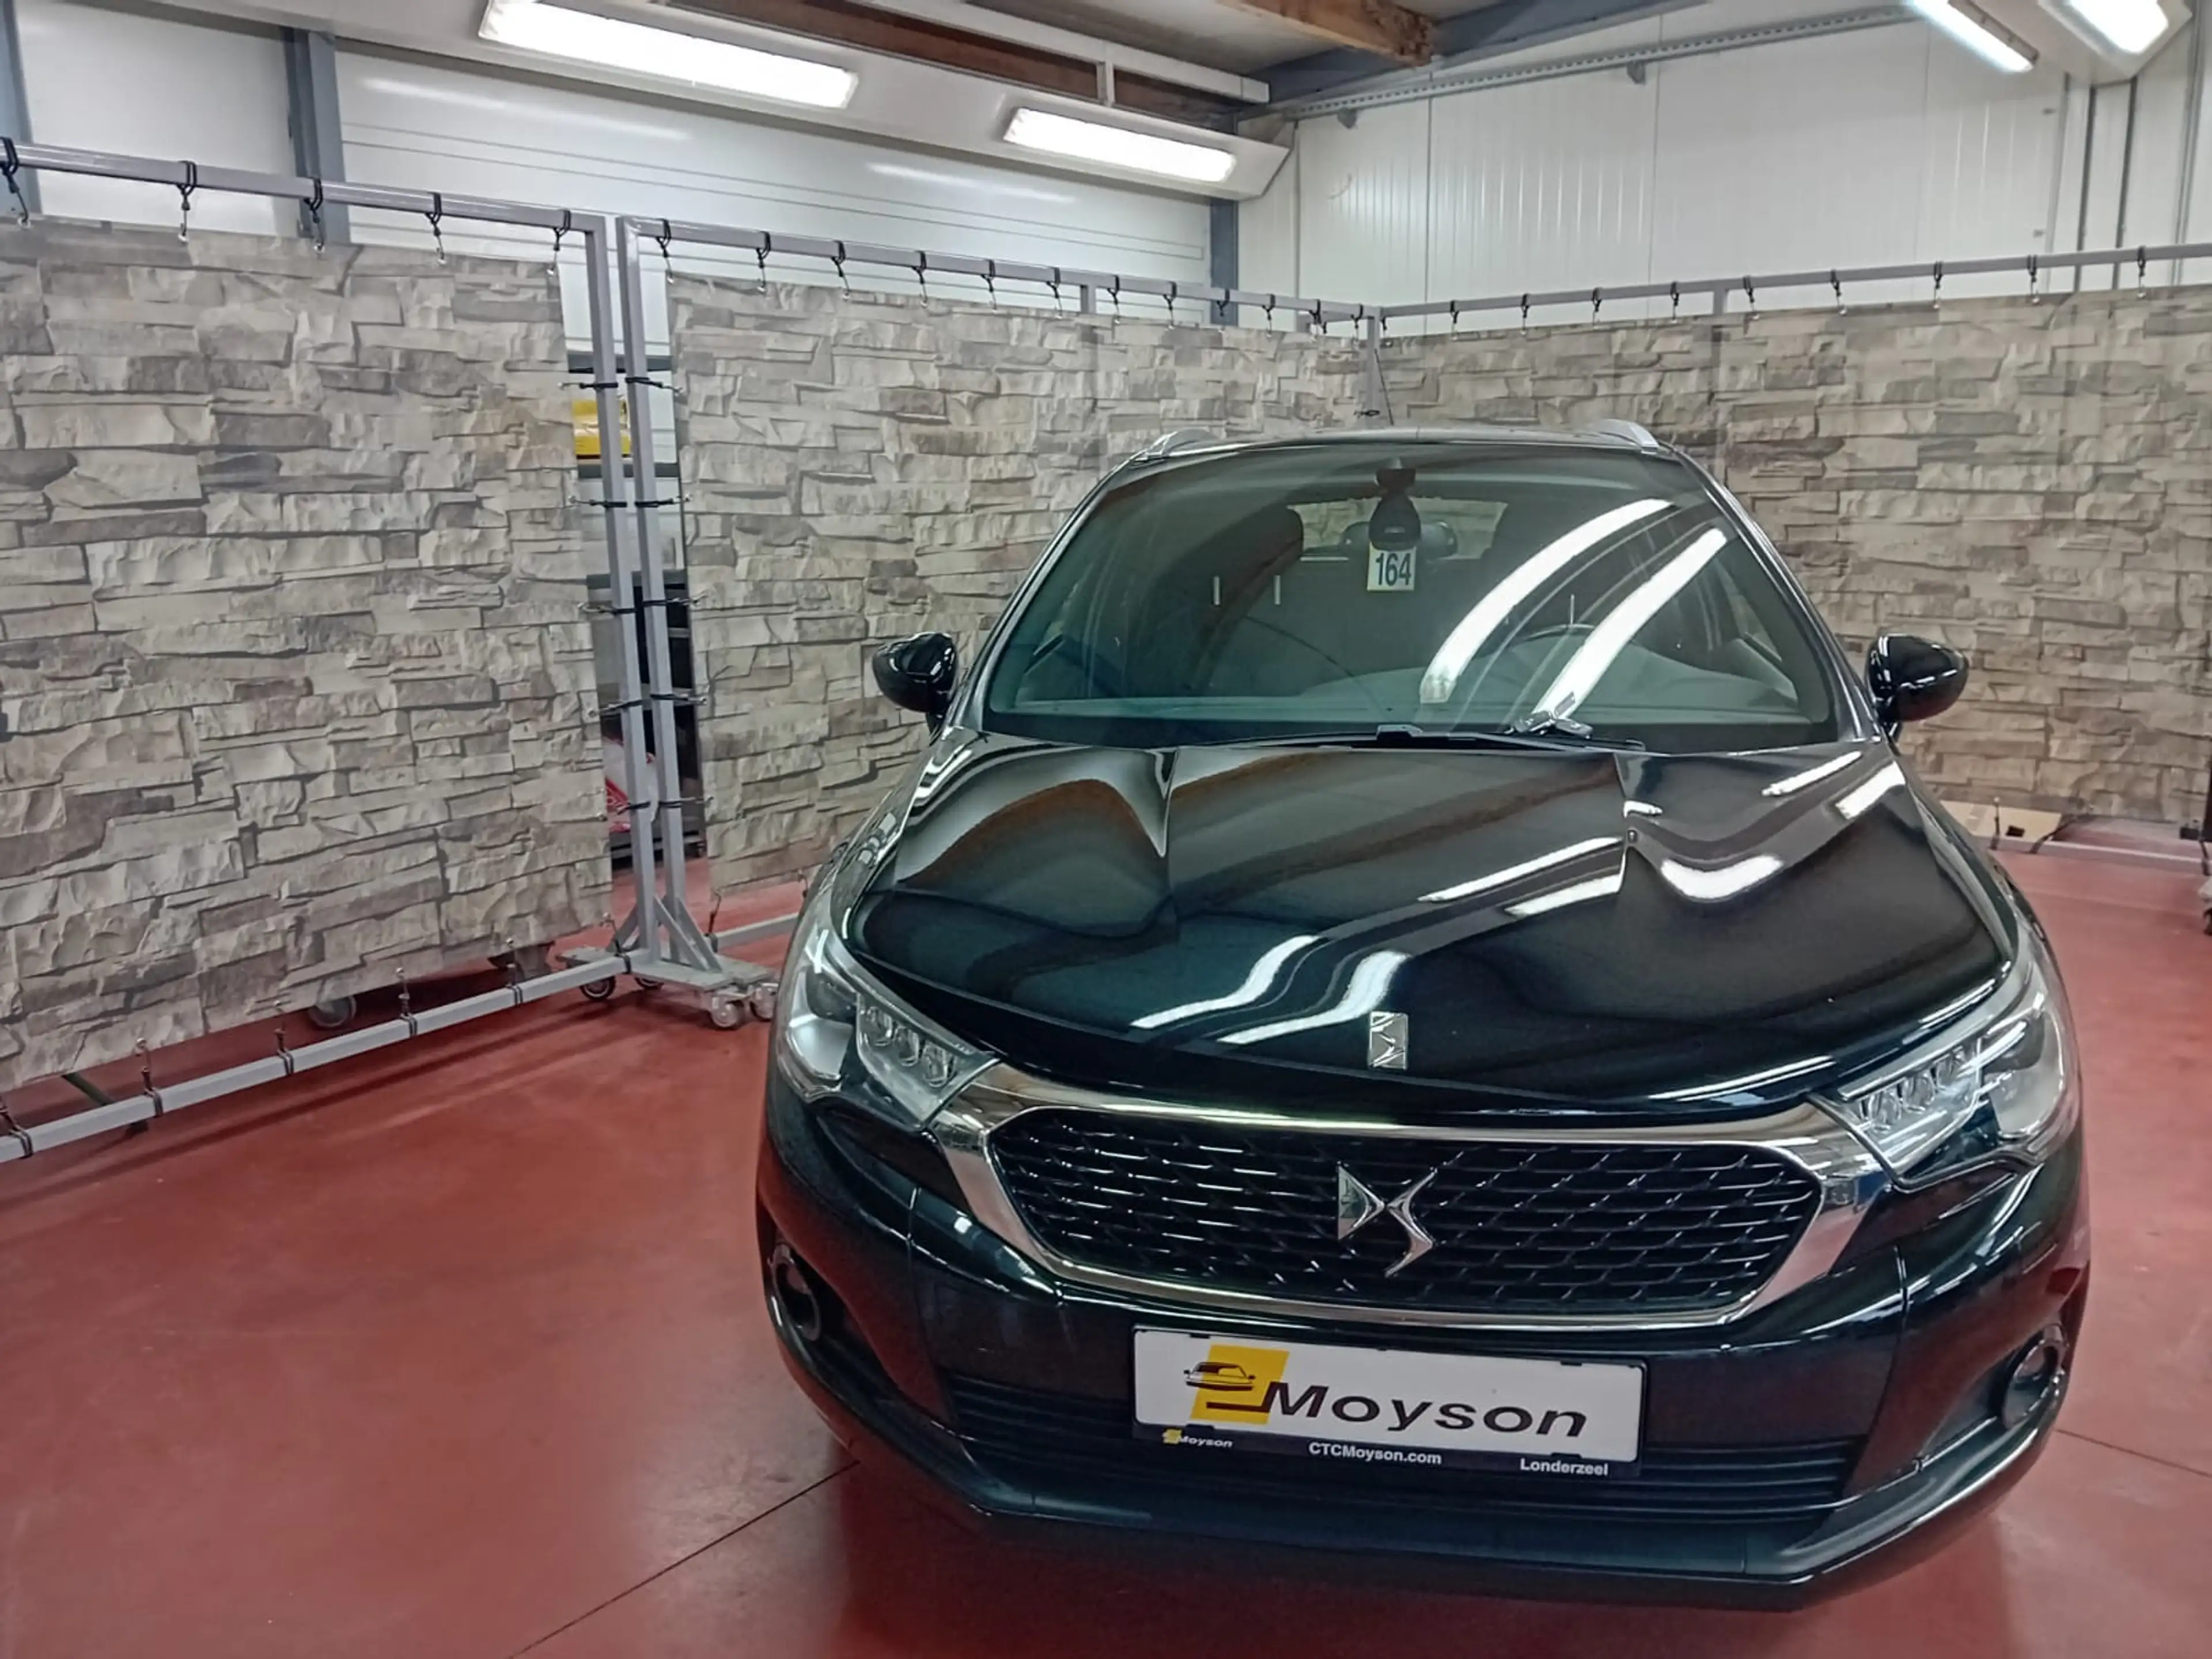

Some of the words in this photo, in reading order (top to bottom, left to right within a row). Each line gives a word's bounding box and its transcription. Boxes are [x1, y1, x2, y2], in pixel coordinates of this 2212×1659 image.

[1376, 553, 1411, 586] 164
[1267, 1381, 1587, 1437] Moyson
[1309, 1442, 1442, 1464] CTCMoyson.com
[1520, 1457, 1608, 1476] Londerzeel
